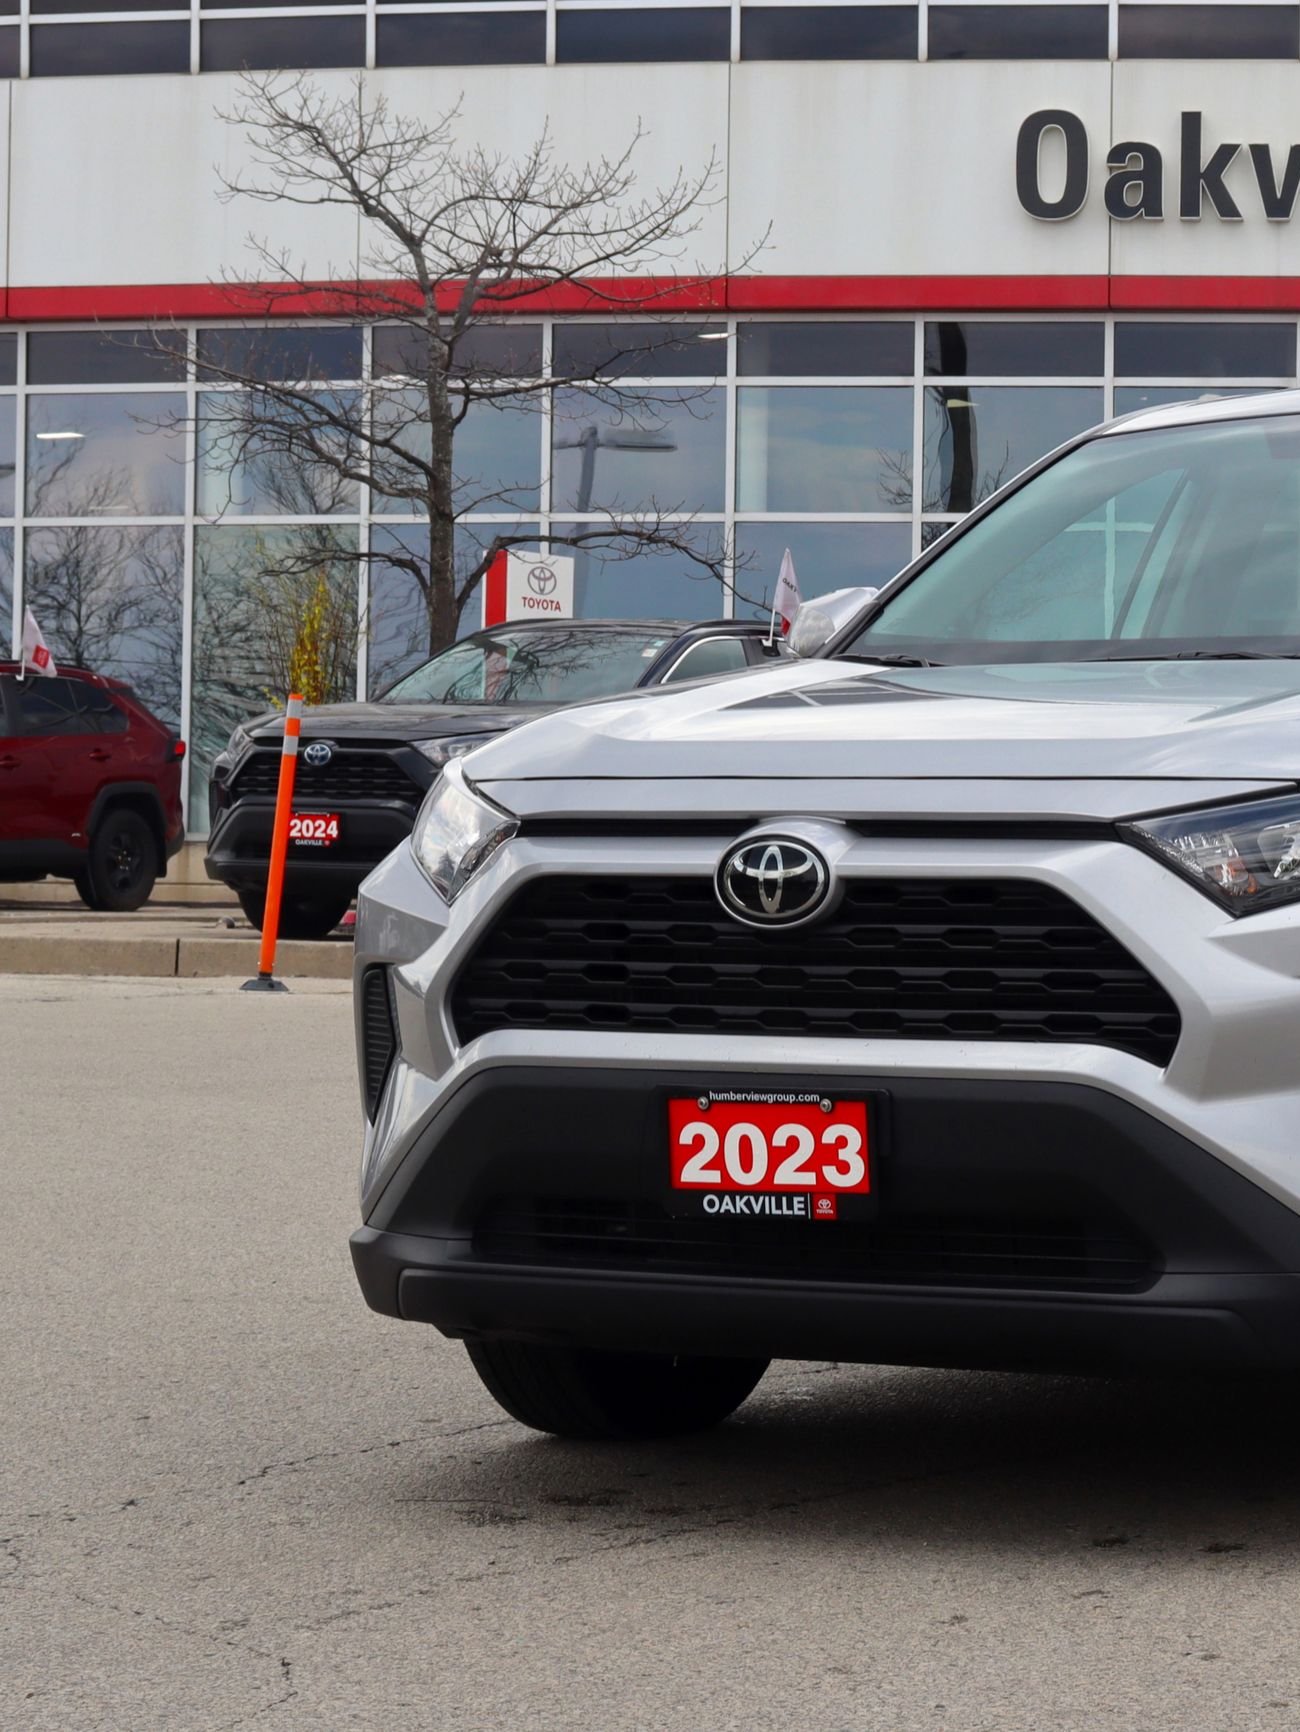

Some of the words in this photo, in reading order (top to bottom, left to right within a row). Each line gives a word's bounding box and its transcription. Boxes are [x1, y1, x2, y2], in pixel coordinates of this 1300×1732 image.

[521, 597, 562, 612] TOYOTA
[289, 818, 338, 838] 2024
[709, 1091, 820, 1104] humberviewgroup.com
[678, 1121, 866, 1188] 2023
[702, 1194, 806, 1216] OAKVILLE
